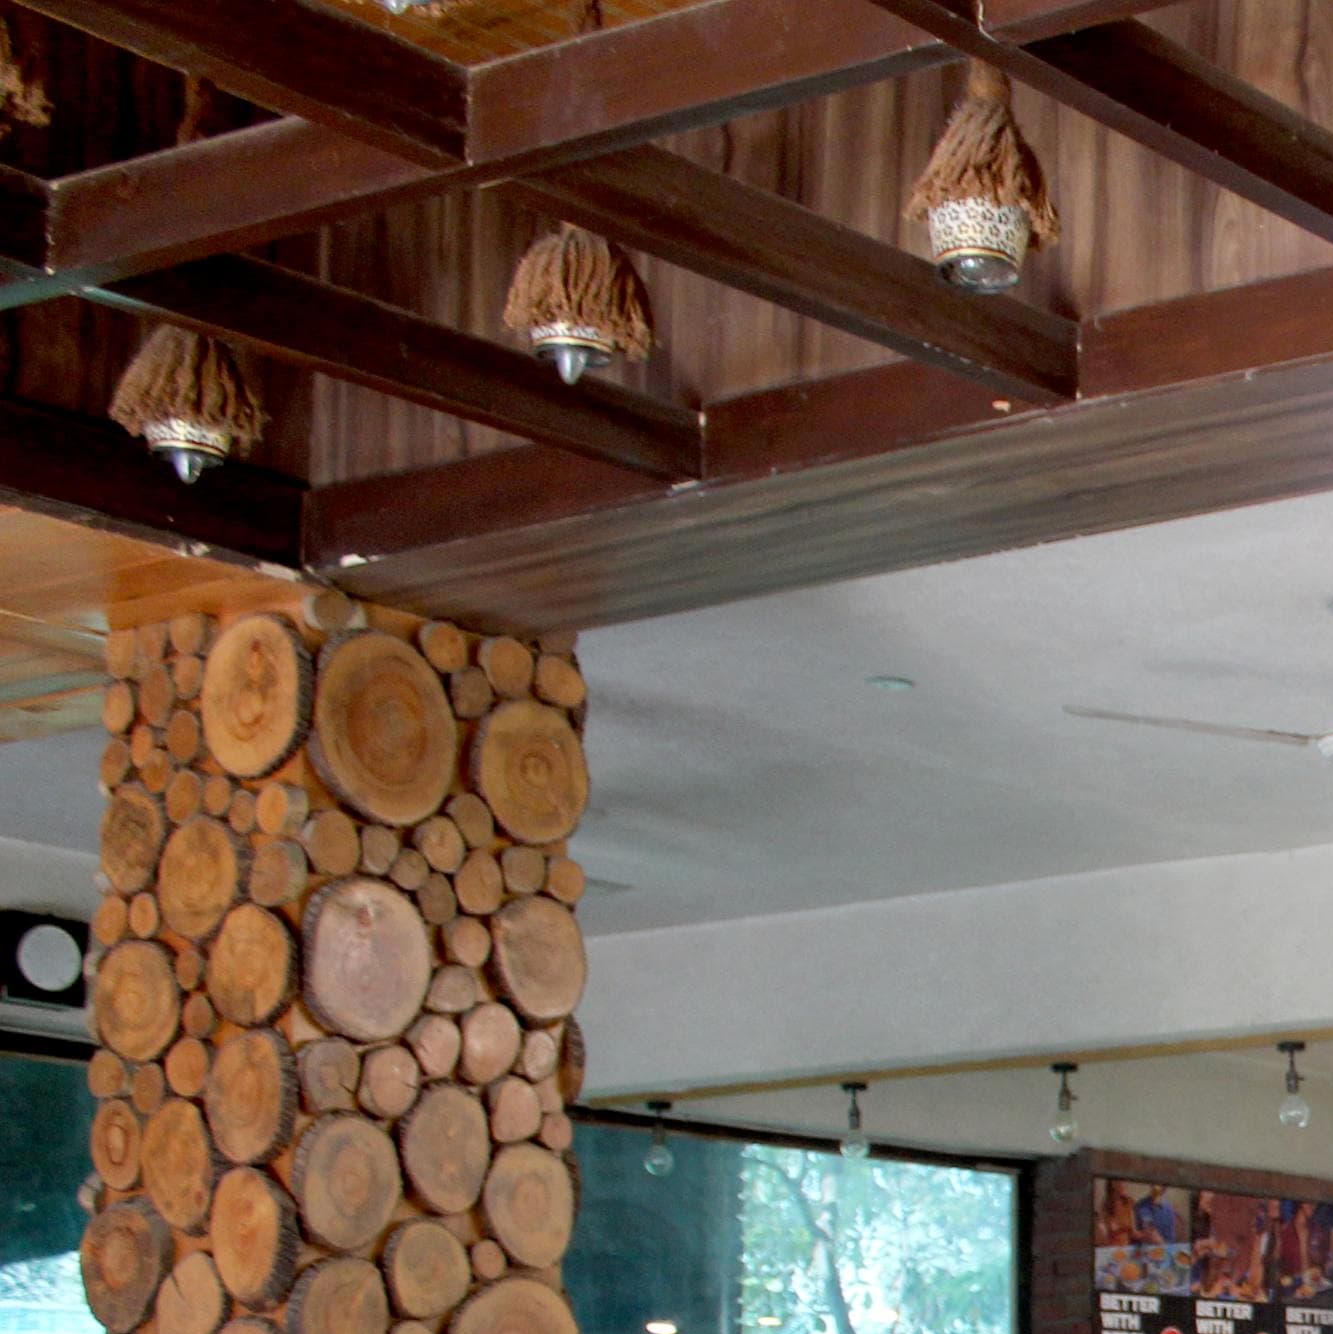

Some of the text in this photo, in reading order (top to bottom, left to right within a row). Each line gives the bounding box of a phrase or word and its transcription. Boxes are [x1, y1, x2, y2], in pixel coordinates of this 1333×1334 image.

[1100, 1293, 1160, 1314] BETTER
[1195, 1300, 1253, 1321] BETTER
[1101, 1312, 1141, 1331] WITH
